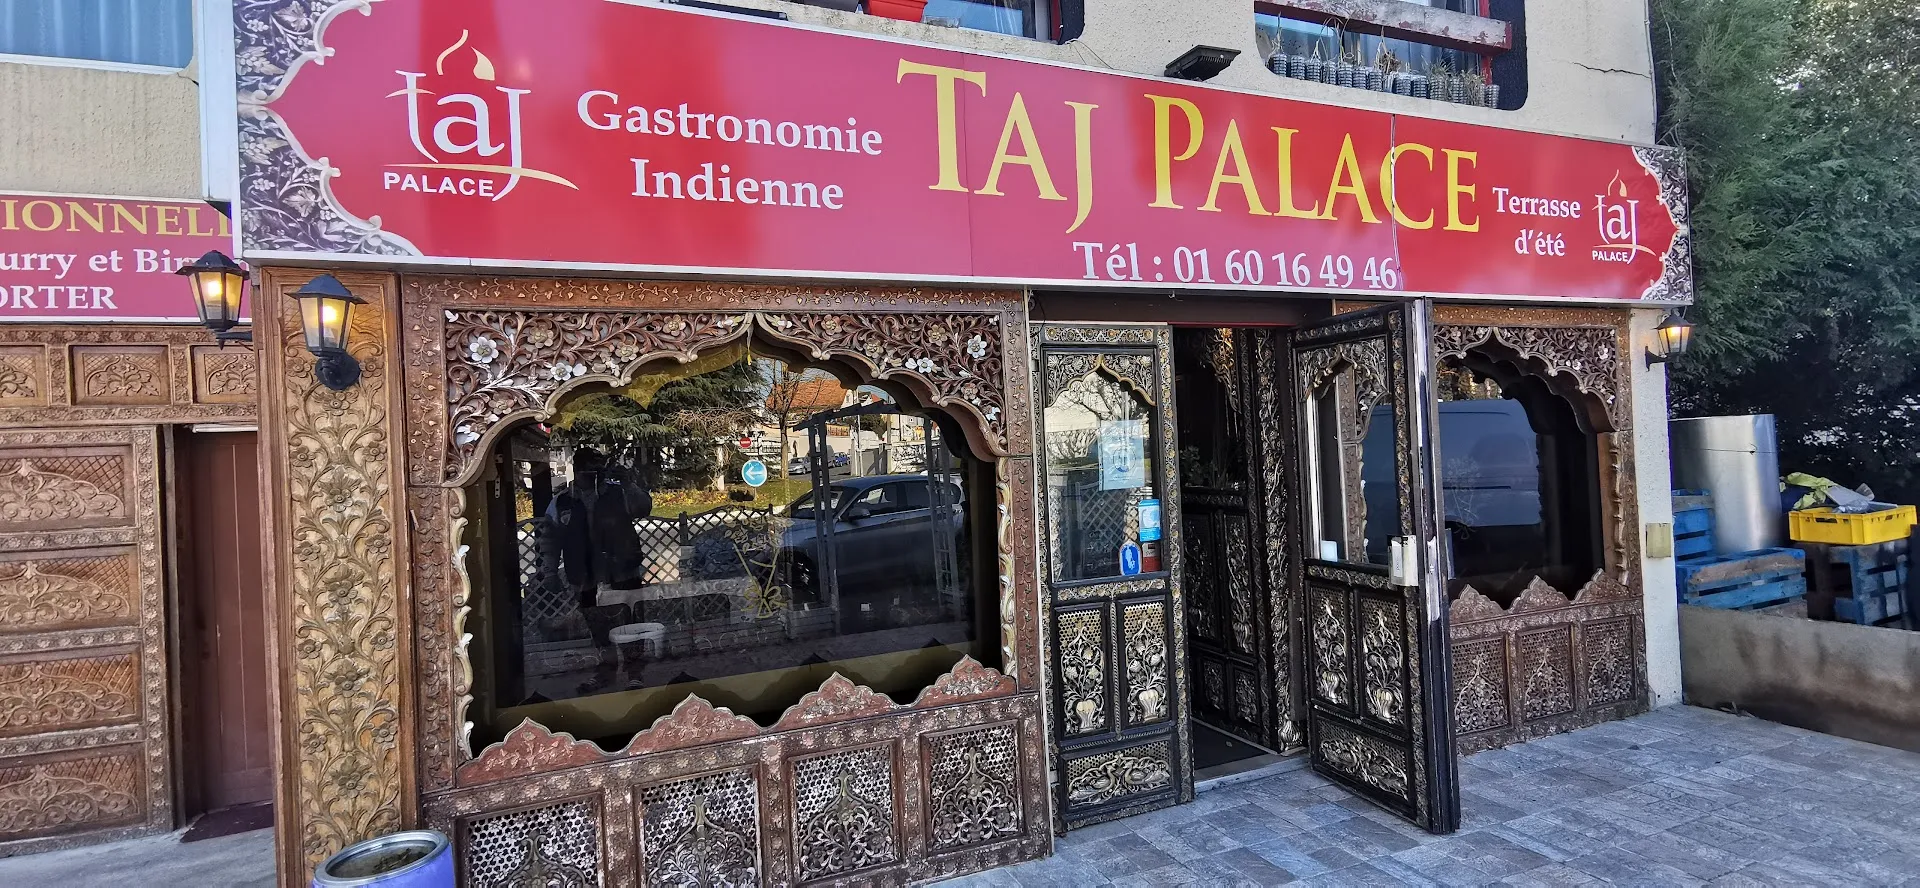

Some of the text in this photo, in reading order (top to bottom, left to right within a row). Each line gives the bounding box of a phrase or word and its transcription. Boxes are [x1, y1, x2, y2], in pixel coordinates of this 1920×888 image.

[577, 89, 884, 156] Gastronomie
[896, 57, 1480, 235] TAJ PALACE
[383, 171, 494, 198] PALACE
[629, 157, 845, 210] Indienne
[1492, 186, 1581, 219] Terrasse
[1514, 228, 1566, 257] d'été
[1592, 250, 1629, 263] PALACE
[0, 249, 250, 280] urry et Bir
[1072, 241, 1398, 290] Tél : 01 60 16 49 46
